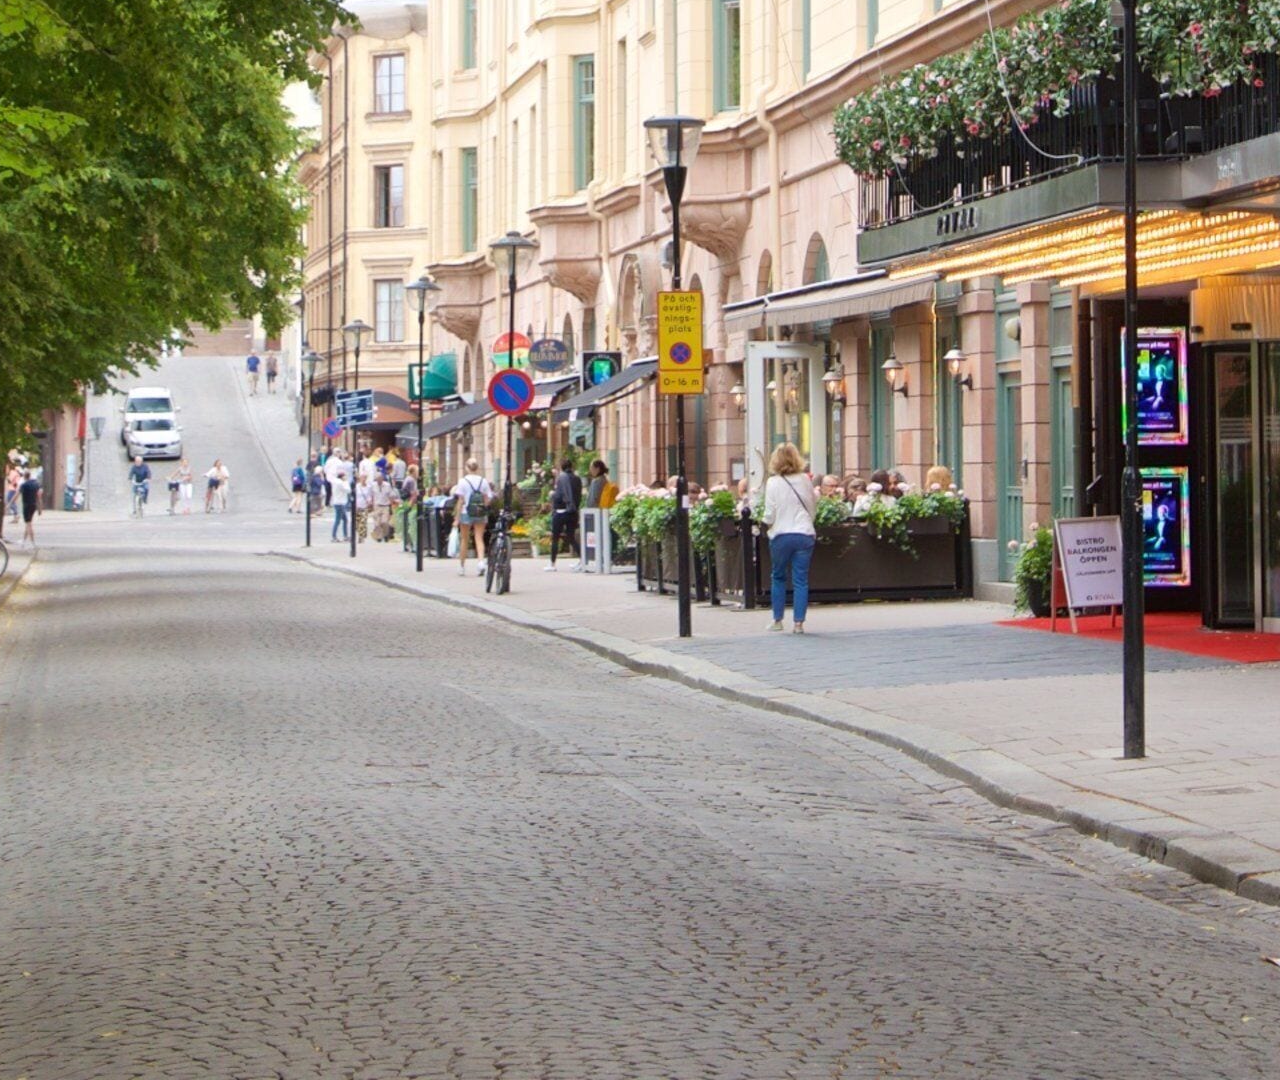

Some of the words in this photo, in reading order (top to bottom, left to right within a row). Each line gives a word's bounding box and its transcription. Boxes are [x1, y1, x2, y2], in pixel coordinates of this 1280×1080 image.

[679, 294, 696, 303] och
[664, 315, 696, 324] nings-
[668, 325, 692, 334] plats
[663, 377, 688, 386] 0-16
[691, 378, 700, 386] m
[1075, 537, 1105, 546] BISTRO
[1067, 546, 1117, 555] BALKONGEN
[1079, 555, 1108, 563] ÖPPEN
